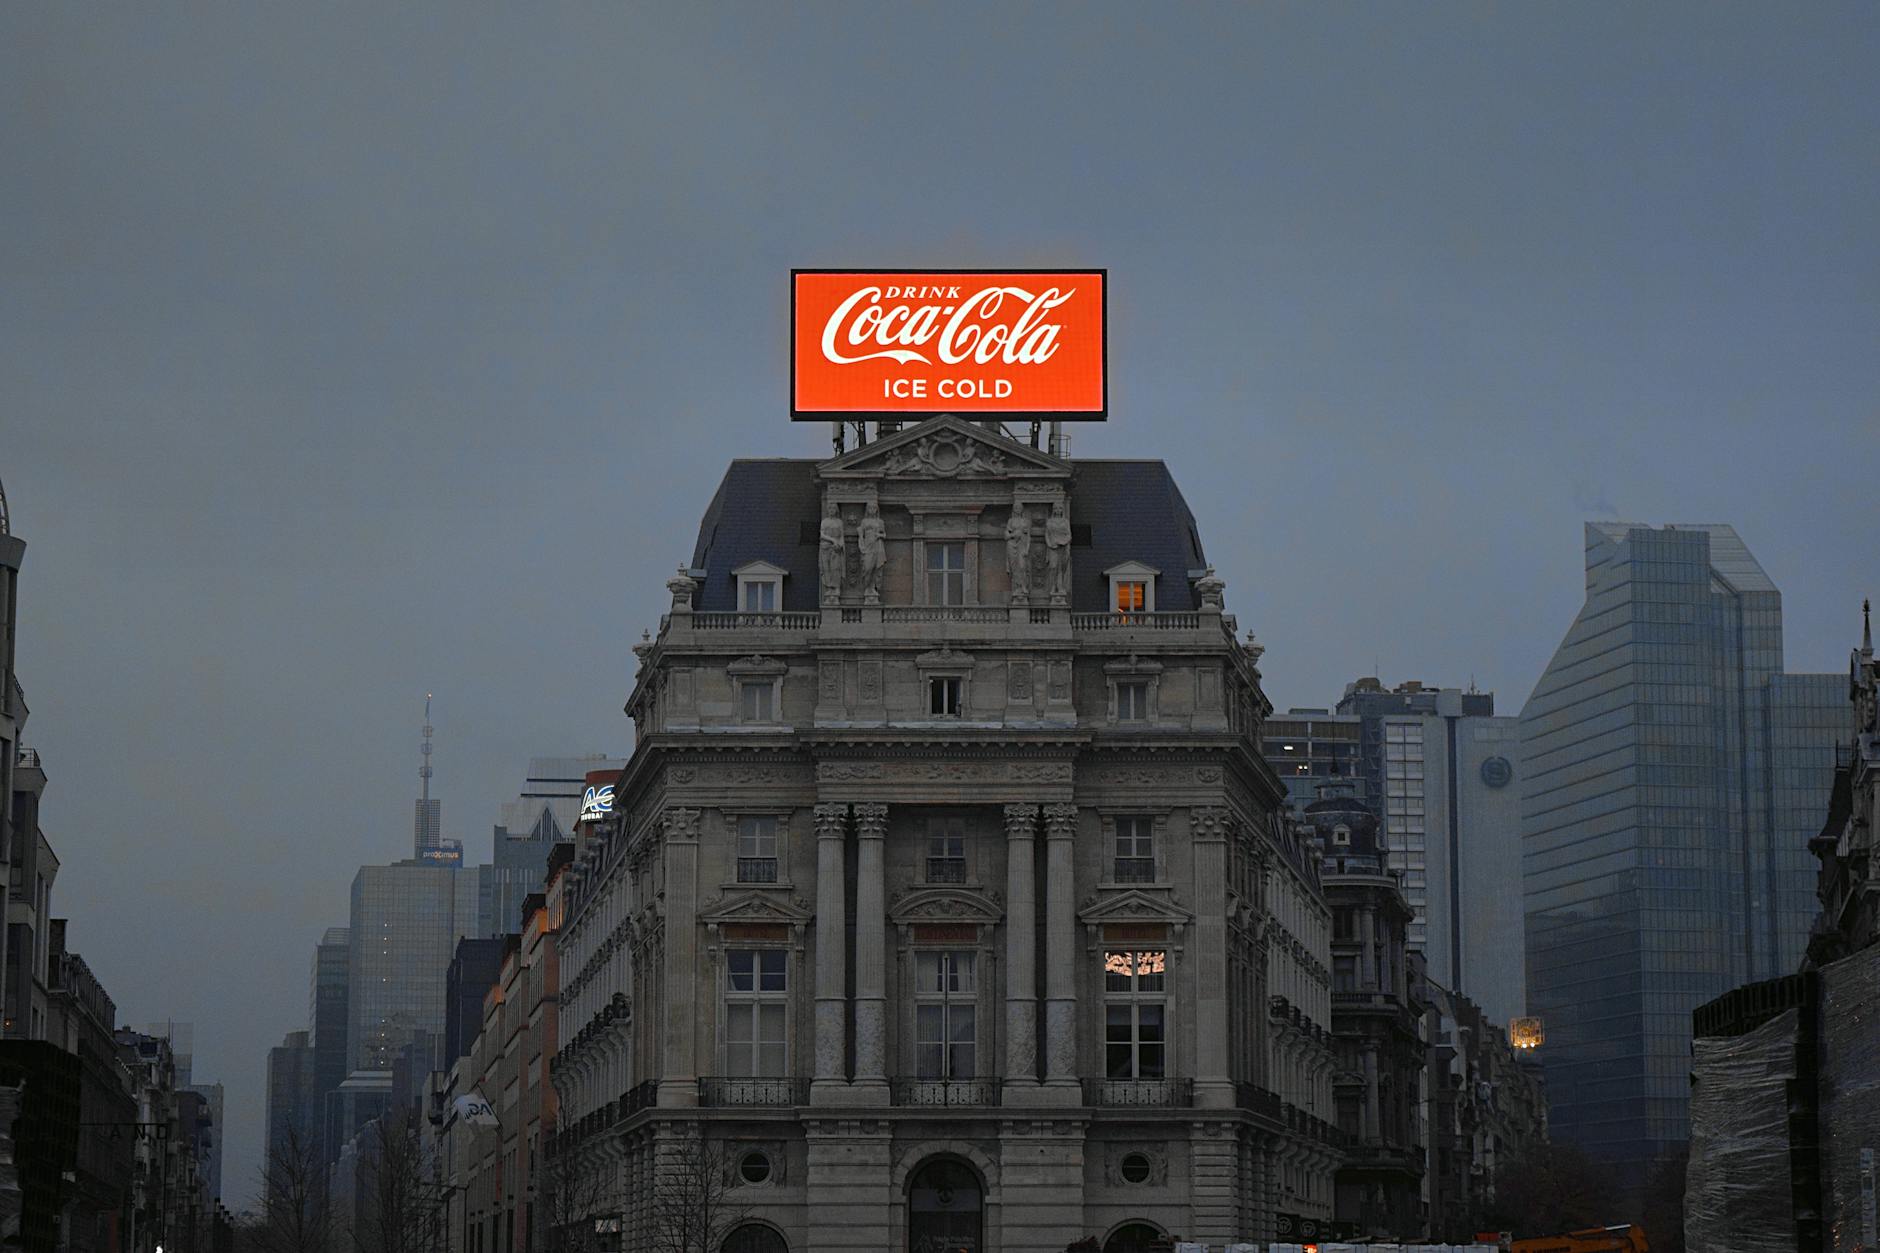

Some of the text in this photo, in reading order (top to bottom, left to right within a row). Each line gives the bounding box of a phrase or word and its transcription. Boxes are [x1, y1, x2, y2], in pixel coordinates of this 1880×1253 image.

[885, 286, 961, 299] DRINK
[821, 286, 1076, 366] Coca-Cola
[884, 379, 1013, 398] ICE COLD
